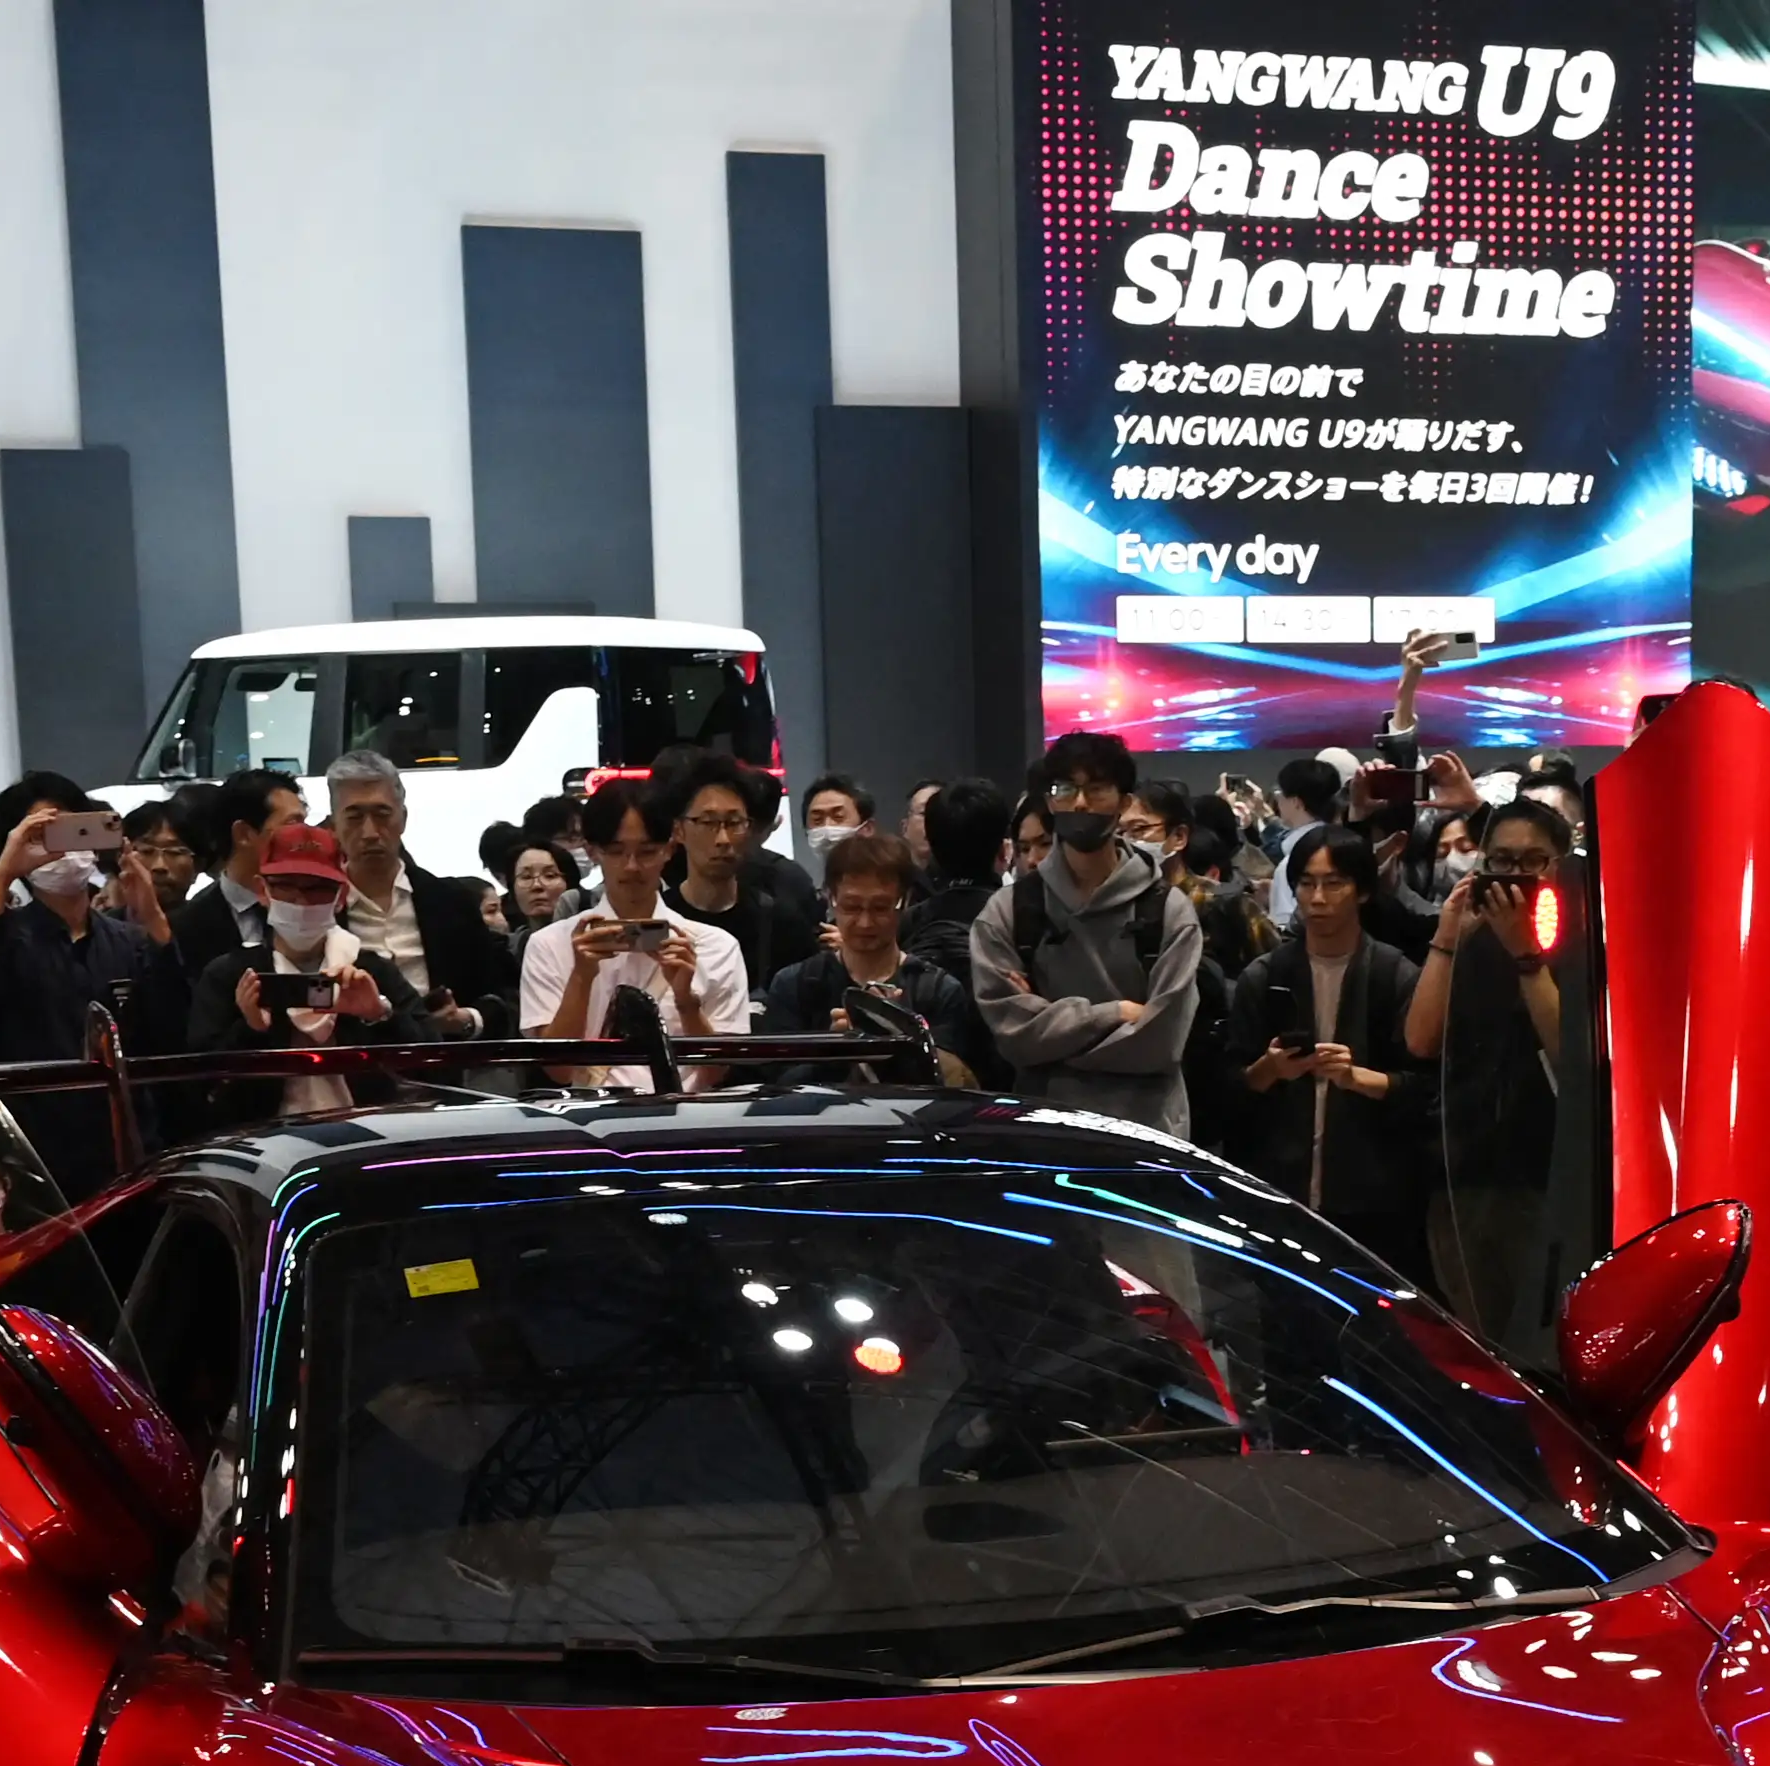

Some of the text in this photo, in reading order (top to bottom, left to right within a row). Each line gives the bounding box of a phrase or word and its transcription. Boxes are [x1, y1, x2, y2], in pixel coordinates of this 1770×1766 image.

[1108, 44, 1616, 141] YANGWANG U9
[1111, 119, 1430, 223] Dance
[1112, 230, 1615, 338] Showtime
[1115, 361, 1364, 398] あなたの目の前で
[1115, 415, 1309, 448] YANGWANG
[1117, 531, 1320, 584] Every day
